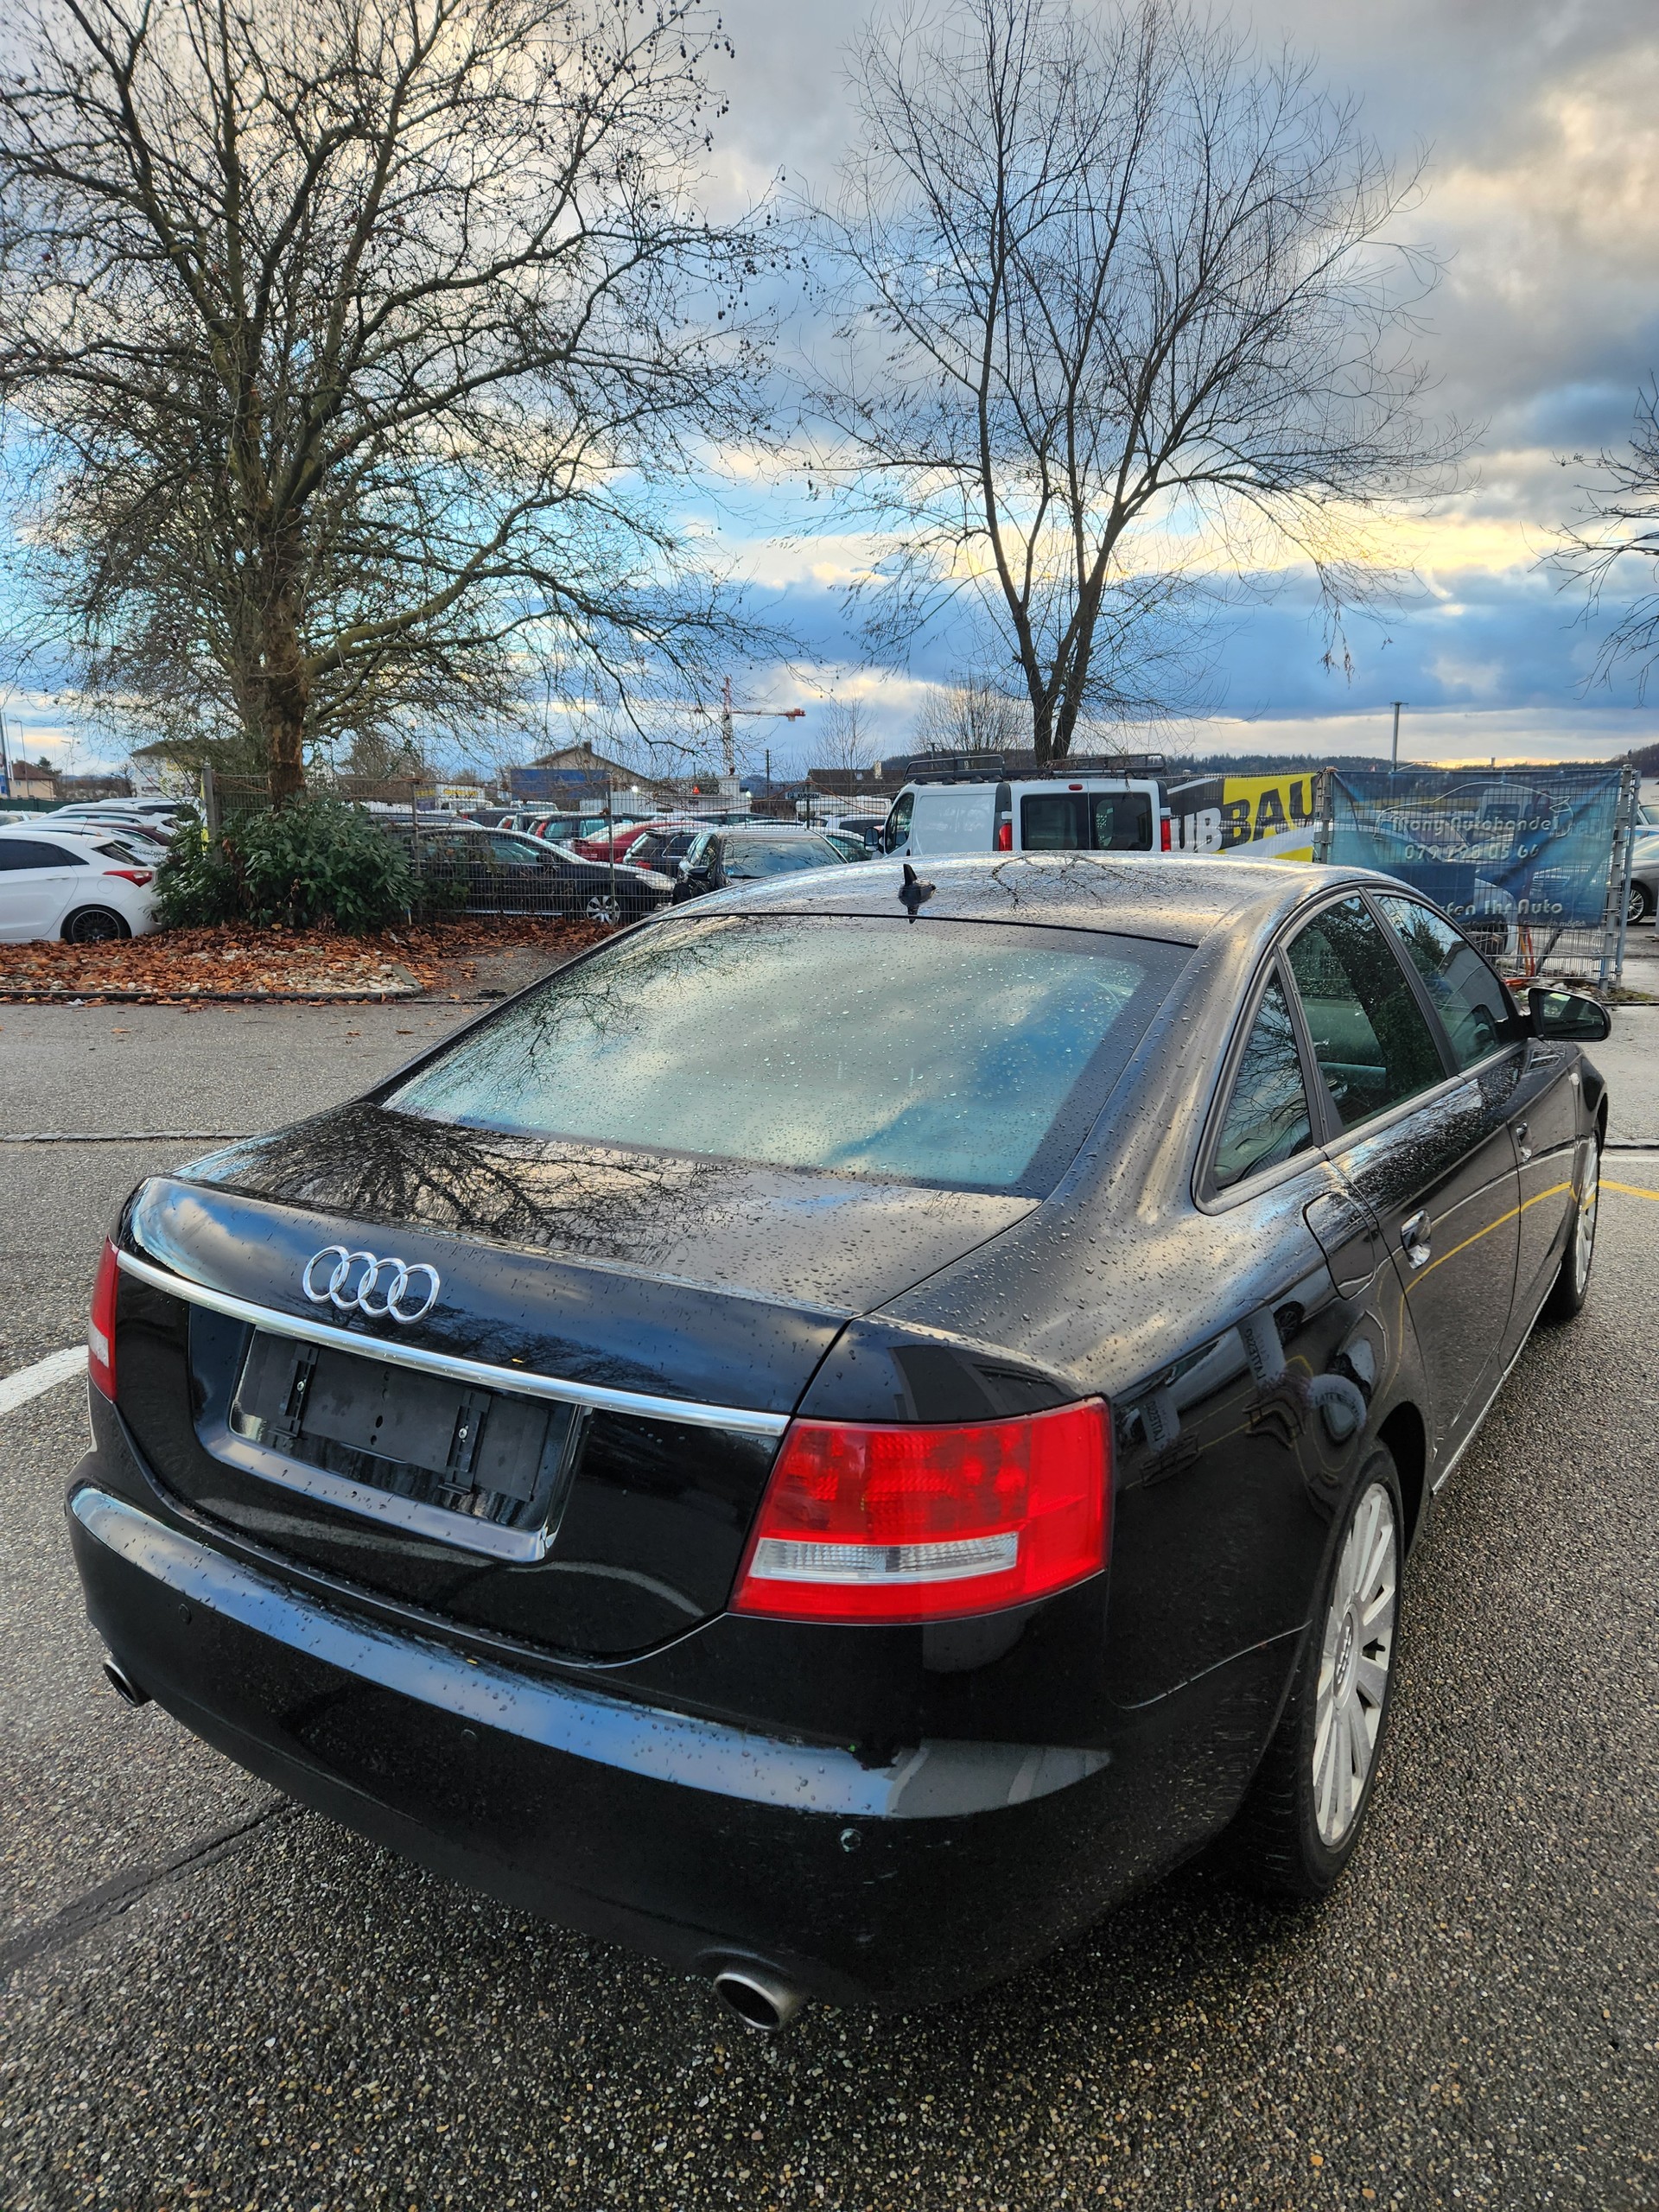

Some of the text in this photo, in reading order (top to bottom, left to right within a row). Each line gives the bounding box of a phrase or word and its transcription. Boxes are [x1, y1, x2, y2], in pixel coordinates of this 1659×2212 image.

[1451, 816, 1559, 831] Autohandel
[1405, 845, 1440, 859] 079
[1489, 844, 1510, 859] 05
[1517, 844, 1539, 859] 66
[1484, 899, 1512, 915] Ihr
[1518, 899, 1563, 915] Auto
